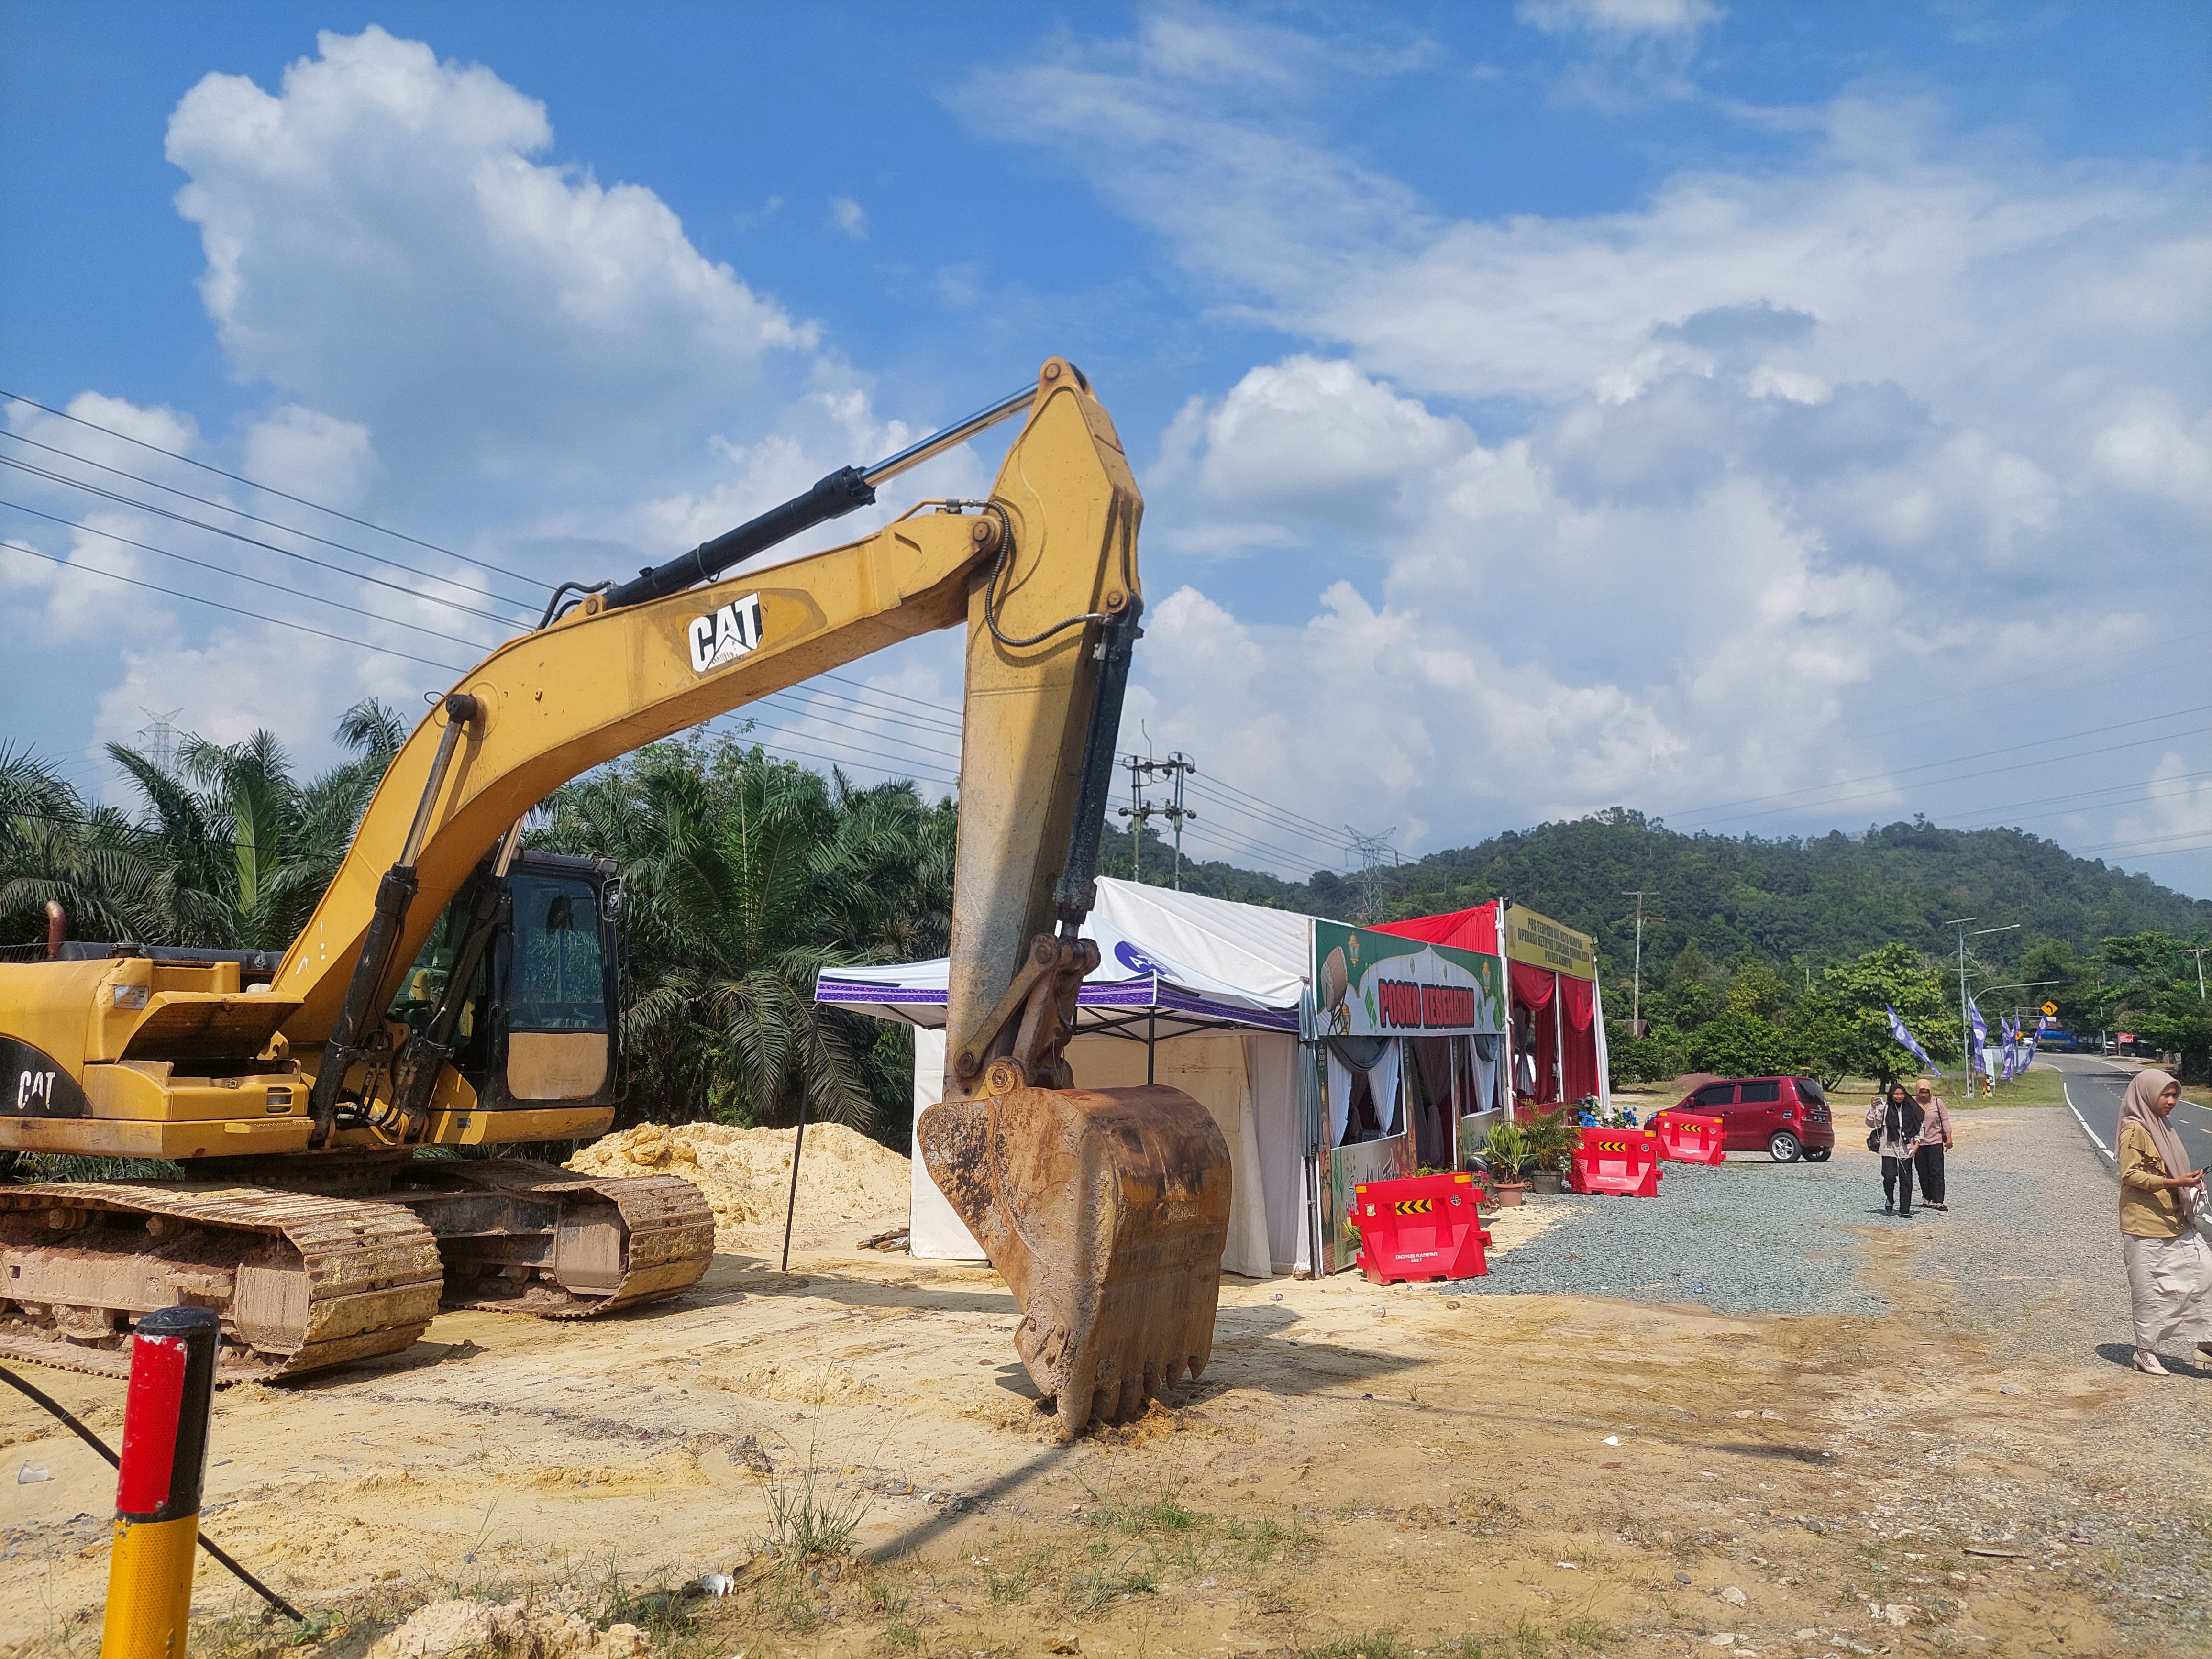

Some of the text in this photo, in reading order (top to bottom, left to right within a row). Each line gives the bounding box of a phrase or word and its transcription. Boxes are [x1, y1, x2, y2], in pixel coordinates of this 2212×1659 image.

[689, 593, 758, 672] CAT
[1518, 927, 1537, 945] OPERASI
[1527, 917, 1536, 932] POS
[1378, 978, 1474, 1029] POSKO KESEHATAN
[18, 1071, 55, 1110] CAT
